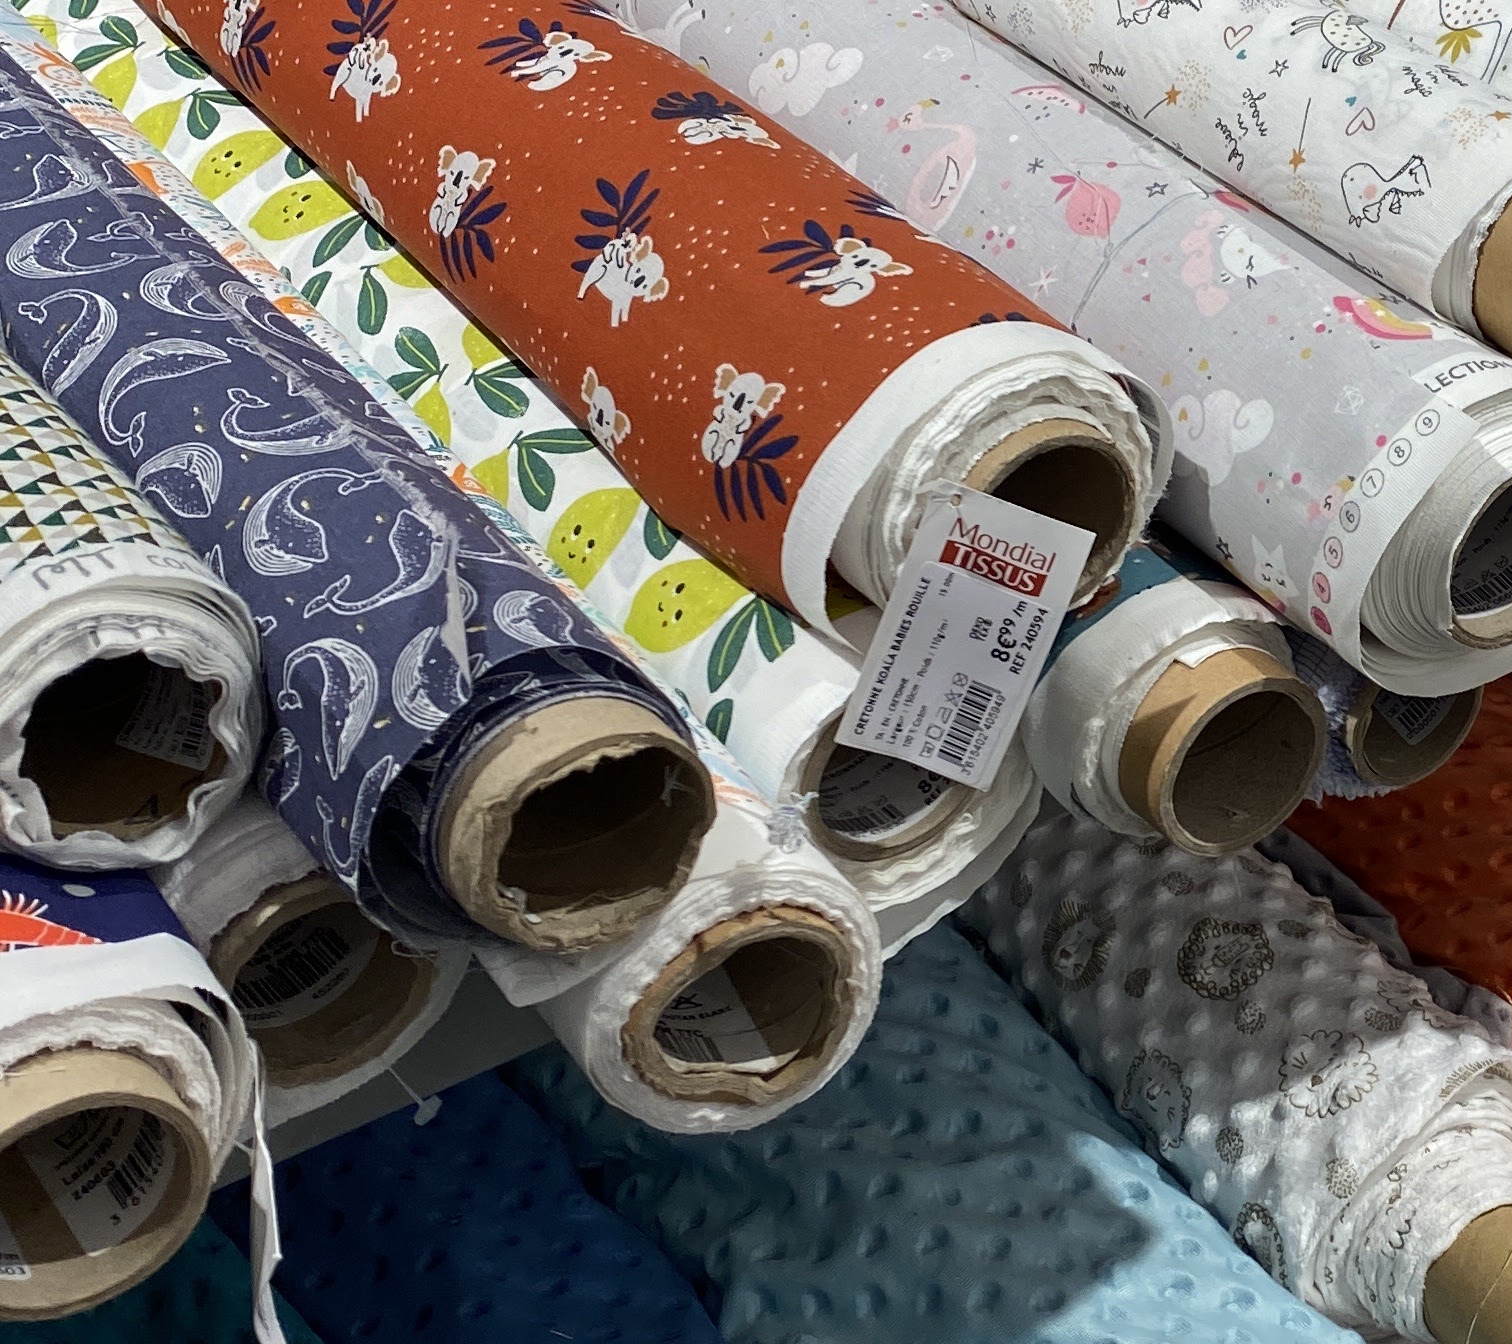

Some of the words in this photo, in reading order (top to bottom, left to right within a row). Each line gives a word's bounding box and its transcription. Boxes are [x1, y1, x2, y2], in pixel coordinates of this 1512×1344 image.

[1395, 446, 1405, 459] 8
[1366, 477, 1379, 489] 7
[949, 517, 1056, 573] Mondial
[951, 542, 1038, 593] TISSUS
[853, 685, 883, 737] CRETONNE
[875, 650, 898, 685] KOALA
[890, 617, 912, 652] BABIES
[905, 575, 931, 618] ROUILLE
[988, 616, 1023, 663] 8€99
[1012, 598, 1029, 618] /m
[1009, 651, 1028, 675] REF
[1020, 606, 1049, 652] 240594
